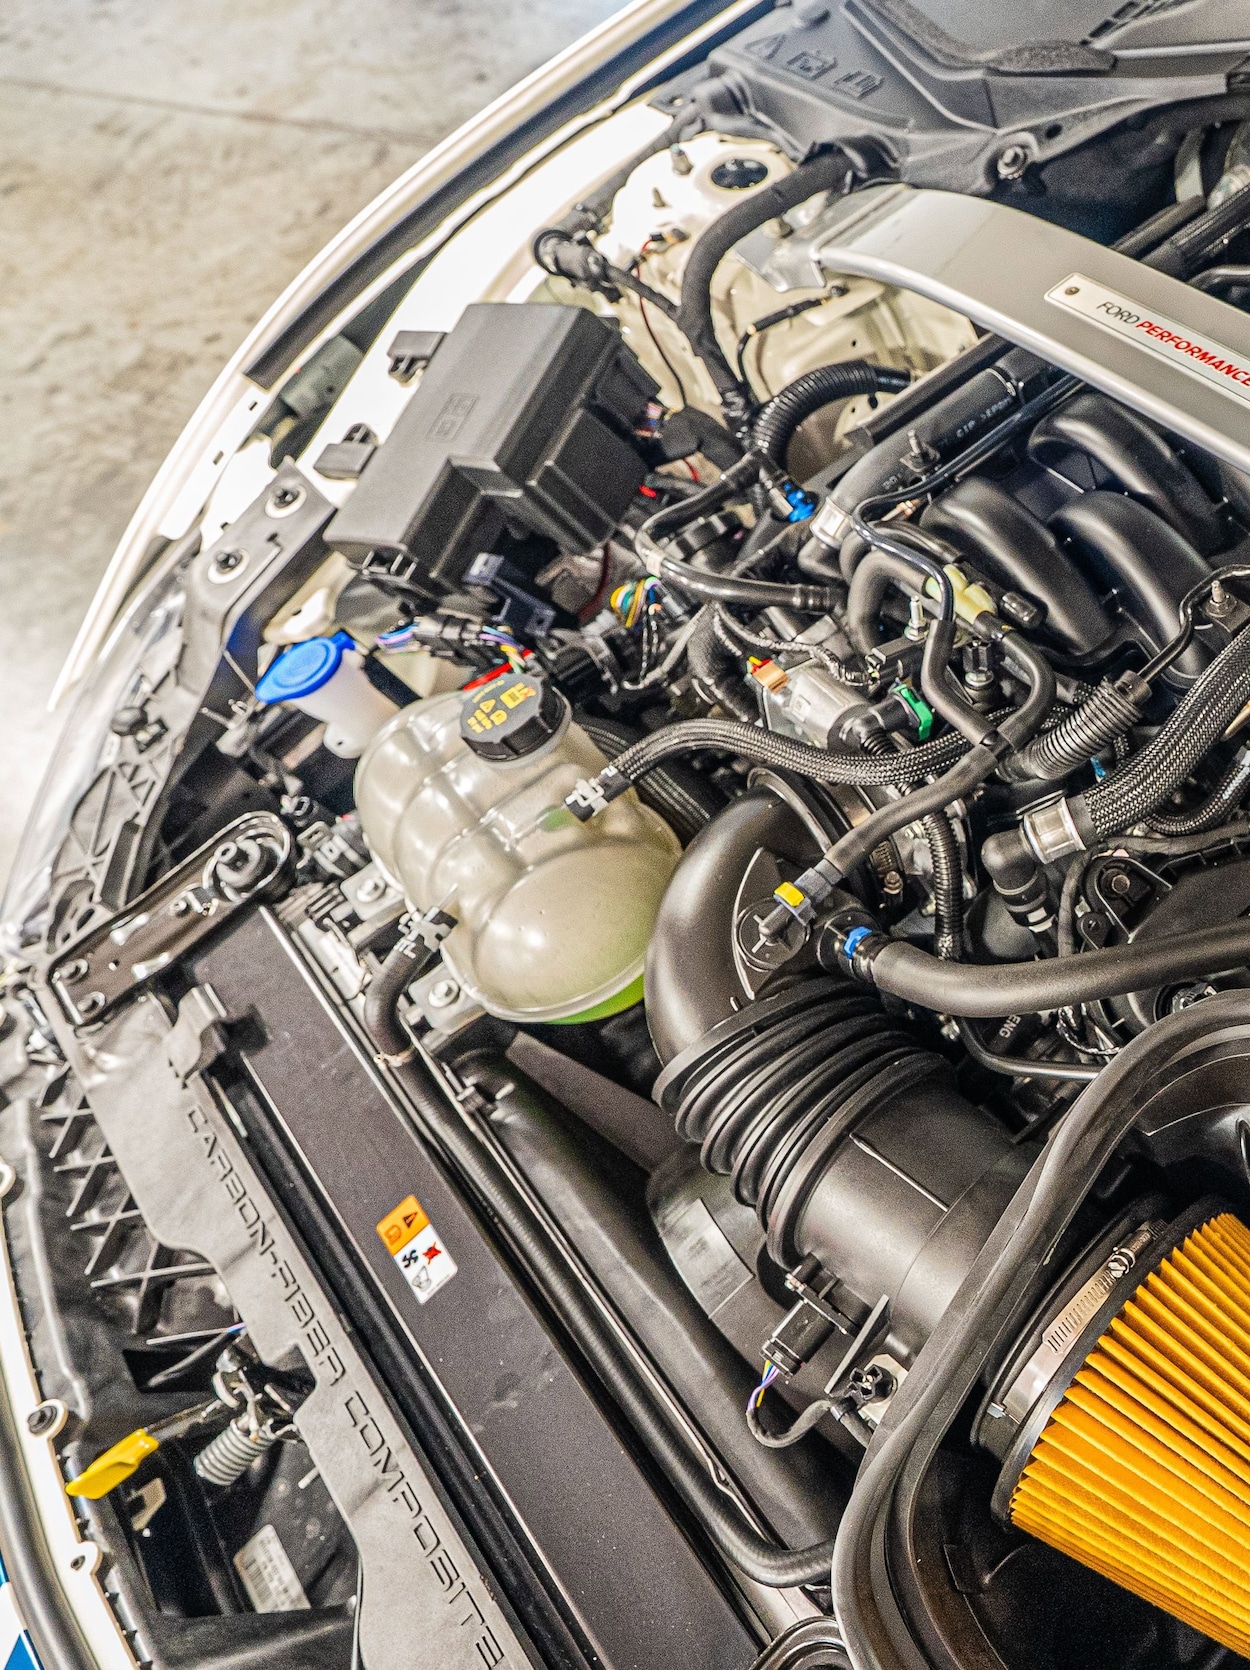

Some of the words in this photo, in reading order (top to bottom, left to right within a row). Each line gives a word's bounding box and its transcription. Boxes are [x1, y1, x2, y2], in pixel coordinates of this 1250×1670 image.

[1097, 301, 1141, 324] FORD
[999, 1014, 1021, 1039] ENG
[188, 1104, 346, 1387] CARBON-FIBER
[344, 1390, 505, 1669] COMPOSITE
